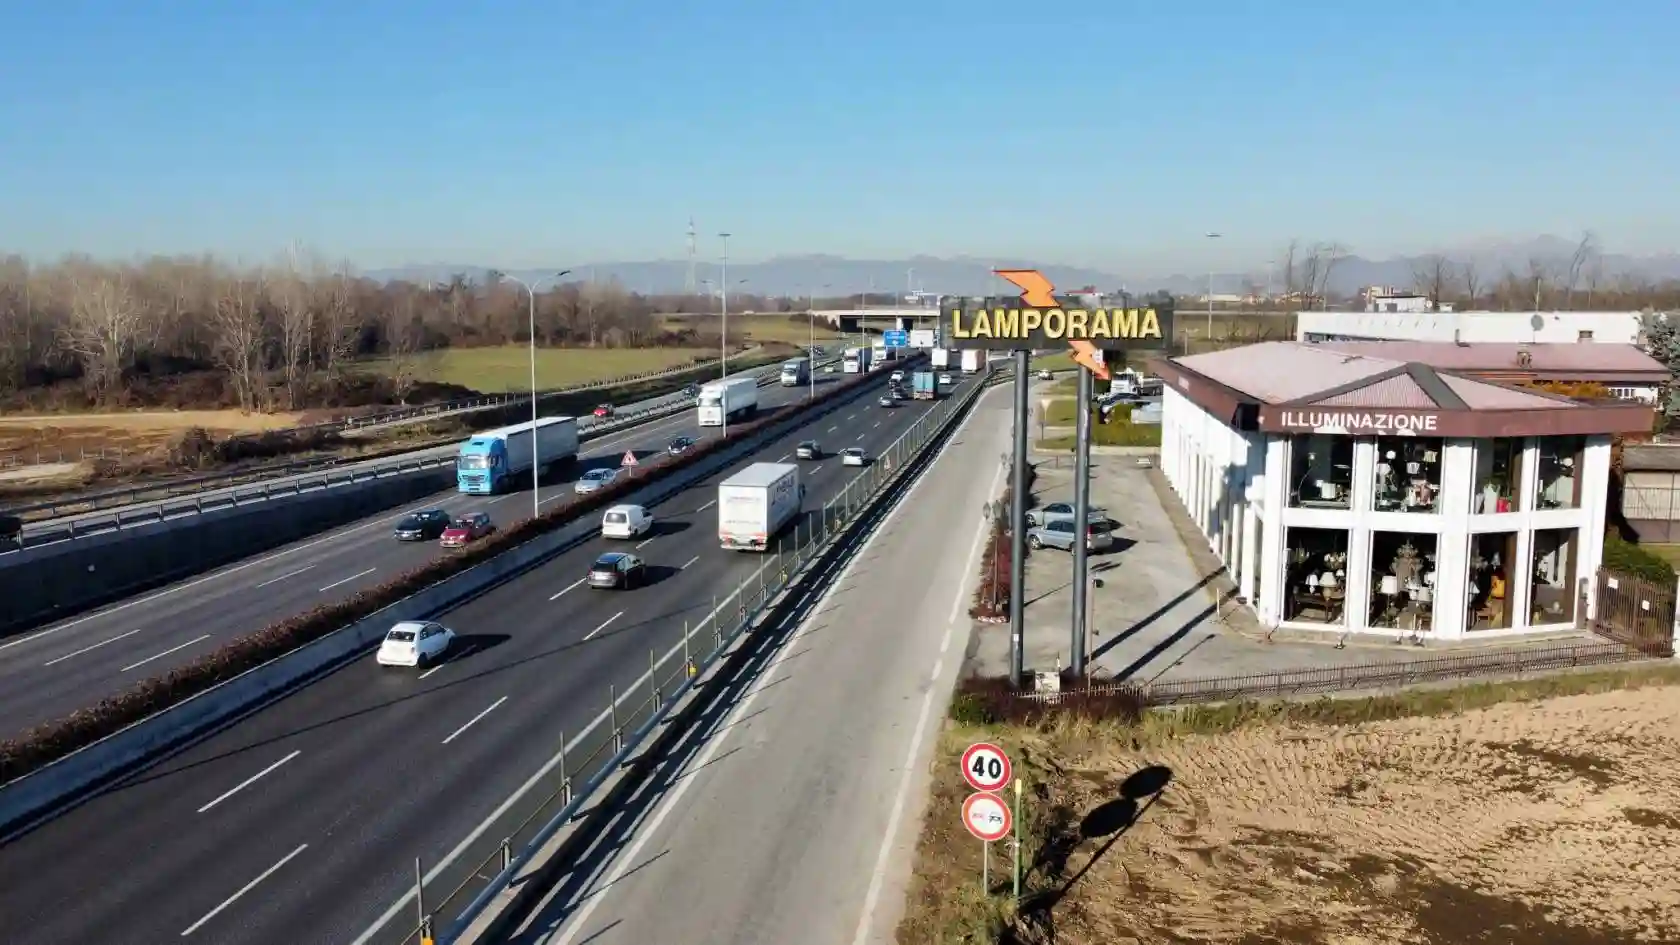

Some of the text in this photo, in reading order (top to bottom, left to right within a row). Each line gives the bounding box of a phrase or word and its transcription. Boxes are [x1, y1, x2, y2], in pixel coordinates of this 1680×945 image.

[953, 309, 1162, 339] LAMPORAMA
[1281, 411, 1437, 430] ILLUMINAZIONE
[973, 756, 1002, 779] 40
